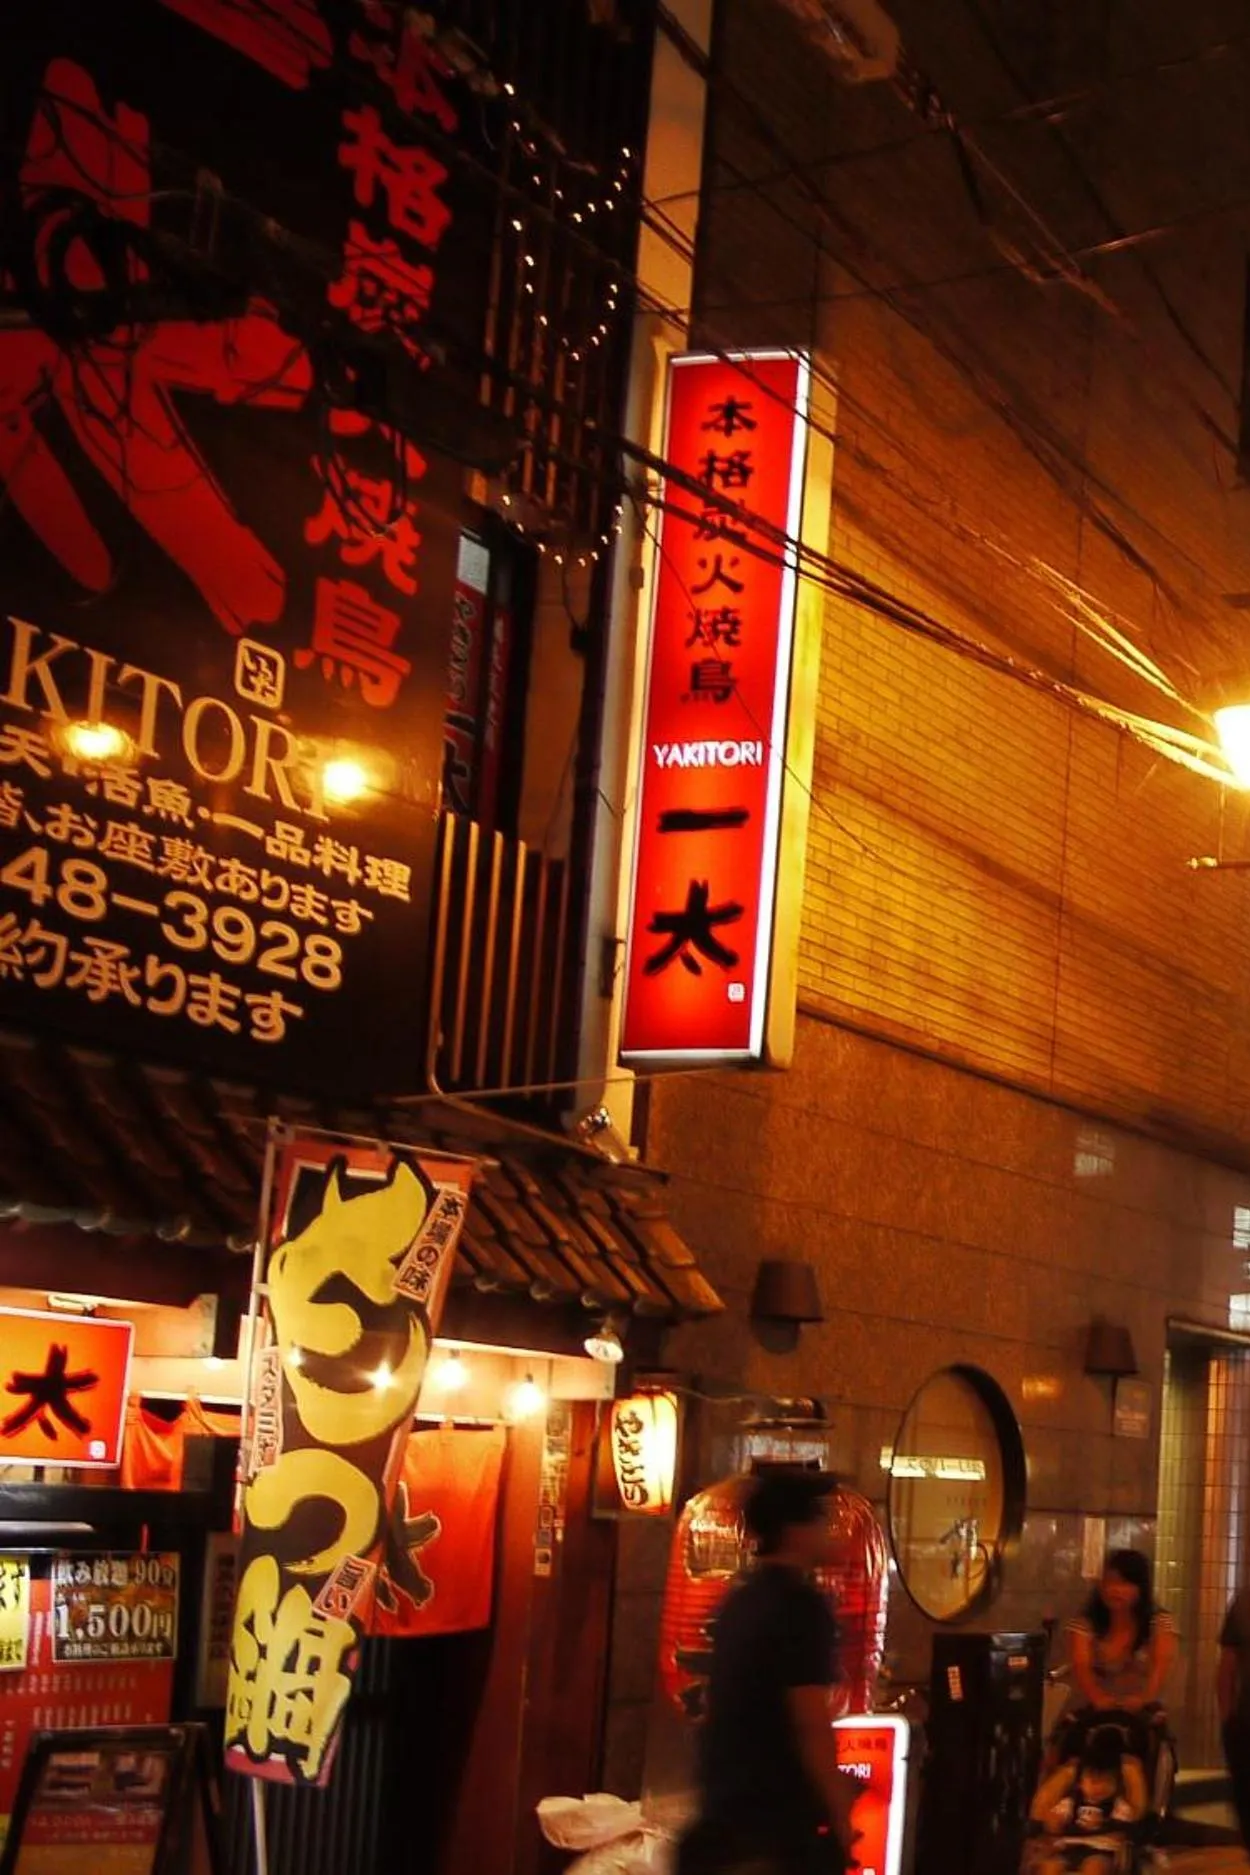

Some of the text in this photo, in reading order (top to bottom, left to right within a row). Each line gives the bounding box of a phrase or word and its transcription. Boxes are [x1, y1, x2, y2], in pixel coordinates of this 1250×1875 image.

[679, 395, 759, 706] 本格炭火焼鳥
[0, 722, 413, 902] 天活魚・一品料理
[652, 739, 764, 770] YAKITORI
[643, 804, 752, 977] 一太
[1, 1343, 100, 1441] 太
